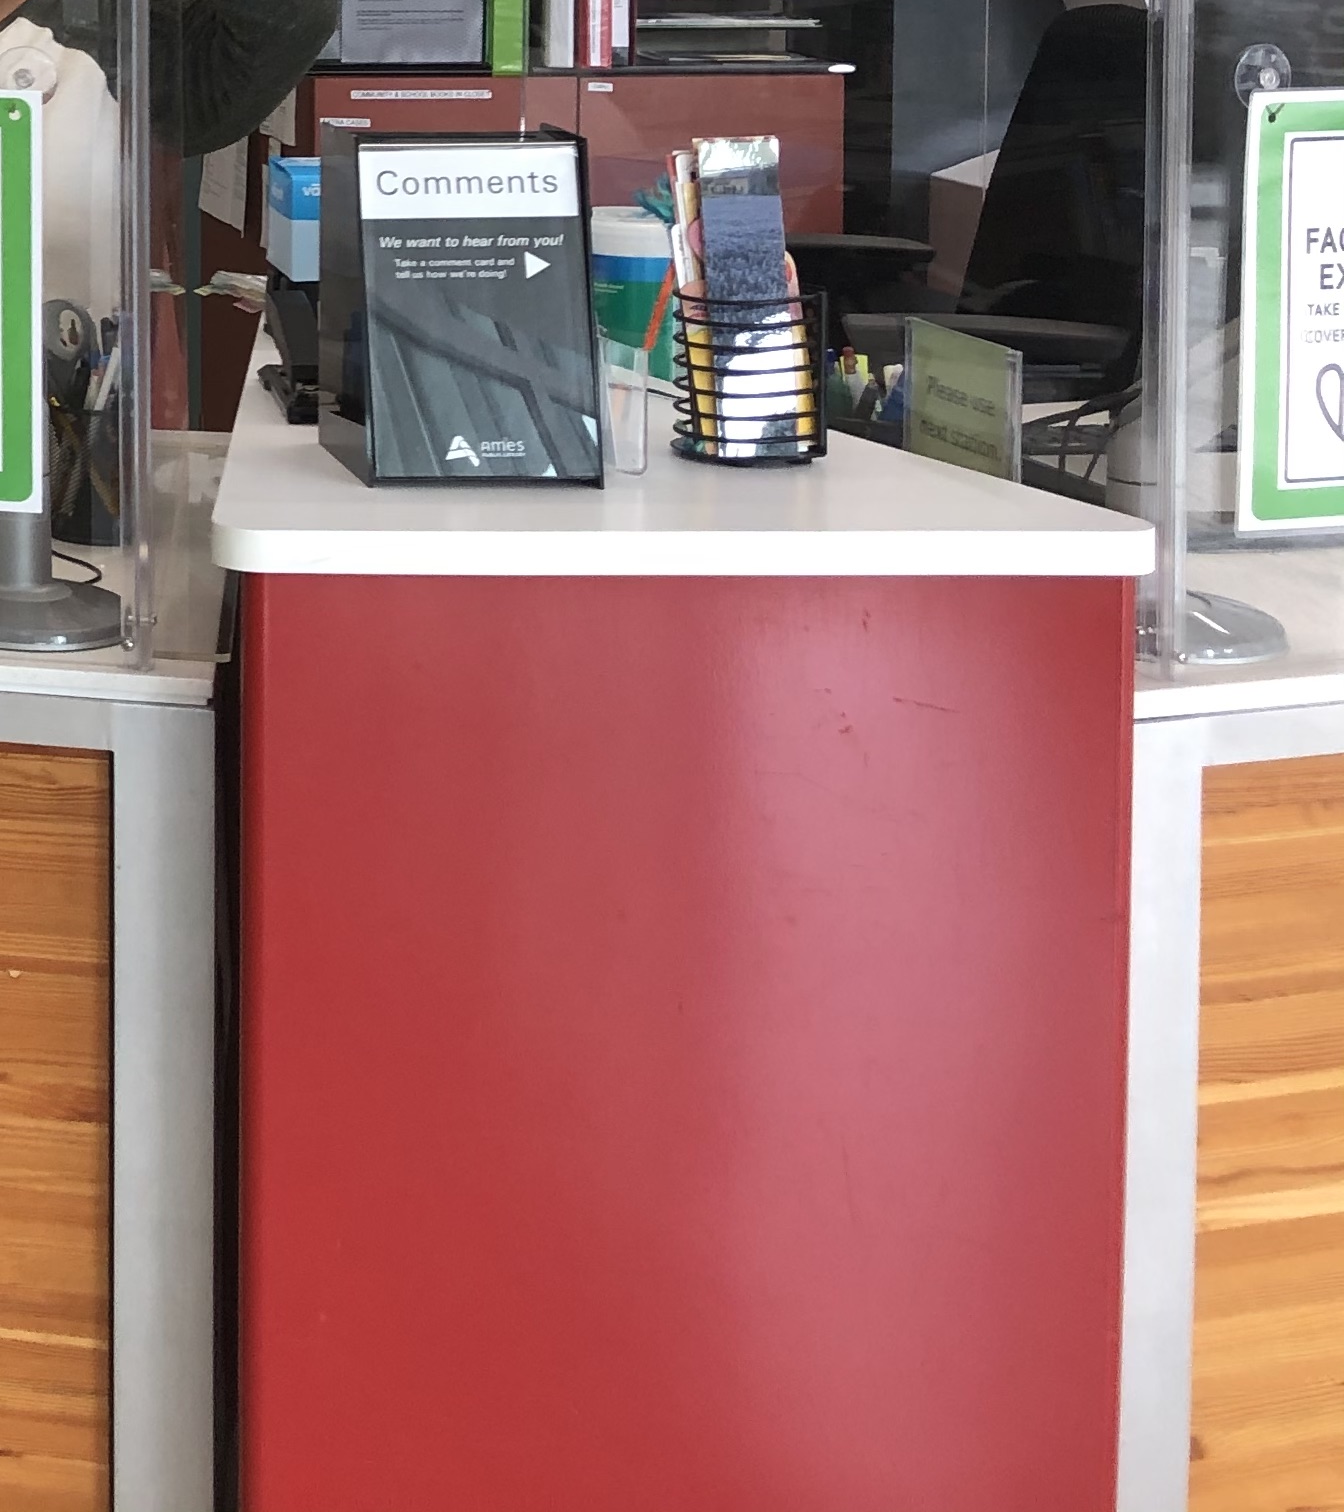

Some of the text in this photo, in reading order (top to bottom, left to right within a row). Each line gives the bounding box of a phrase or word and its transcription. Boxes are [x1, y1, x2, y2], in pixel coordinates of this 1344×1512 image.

[375, 170, 559, 196] Comments
[379, 234, 565, 249] We want to hear from you!
[393, 257, 515, 267] Take a comment card and
[395, 270, 410, 279] tell
[412, 271, 424, 279] us
[426, 270, 447, 279] how
[1307, 302, 1340, 316] TAKE
[927, 375, 969, 407] Please
